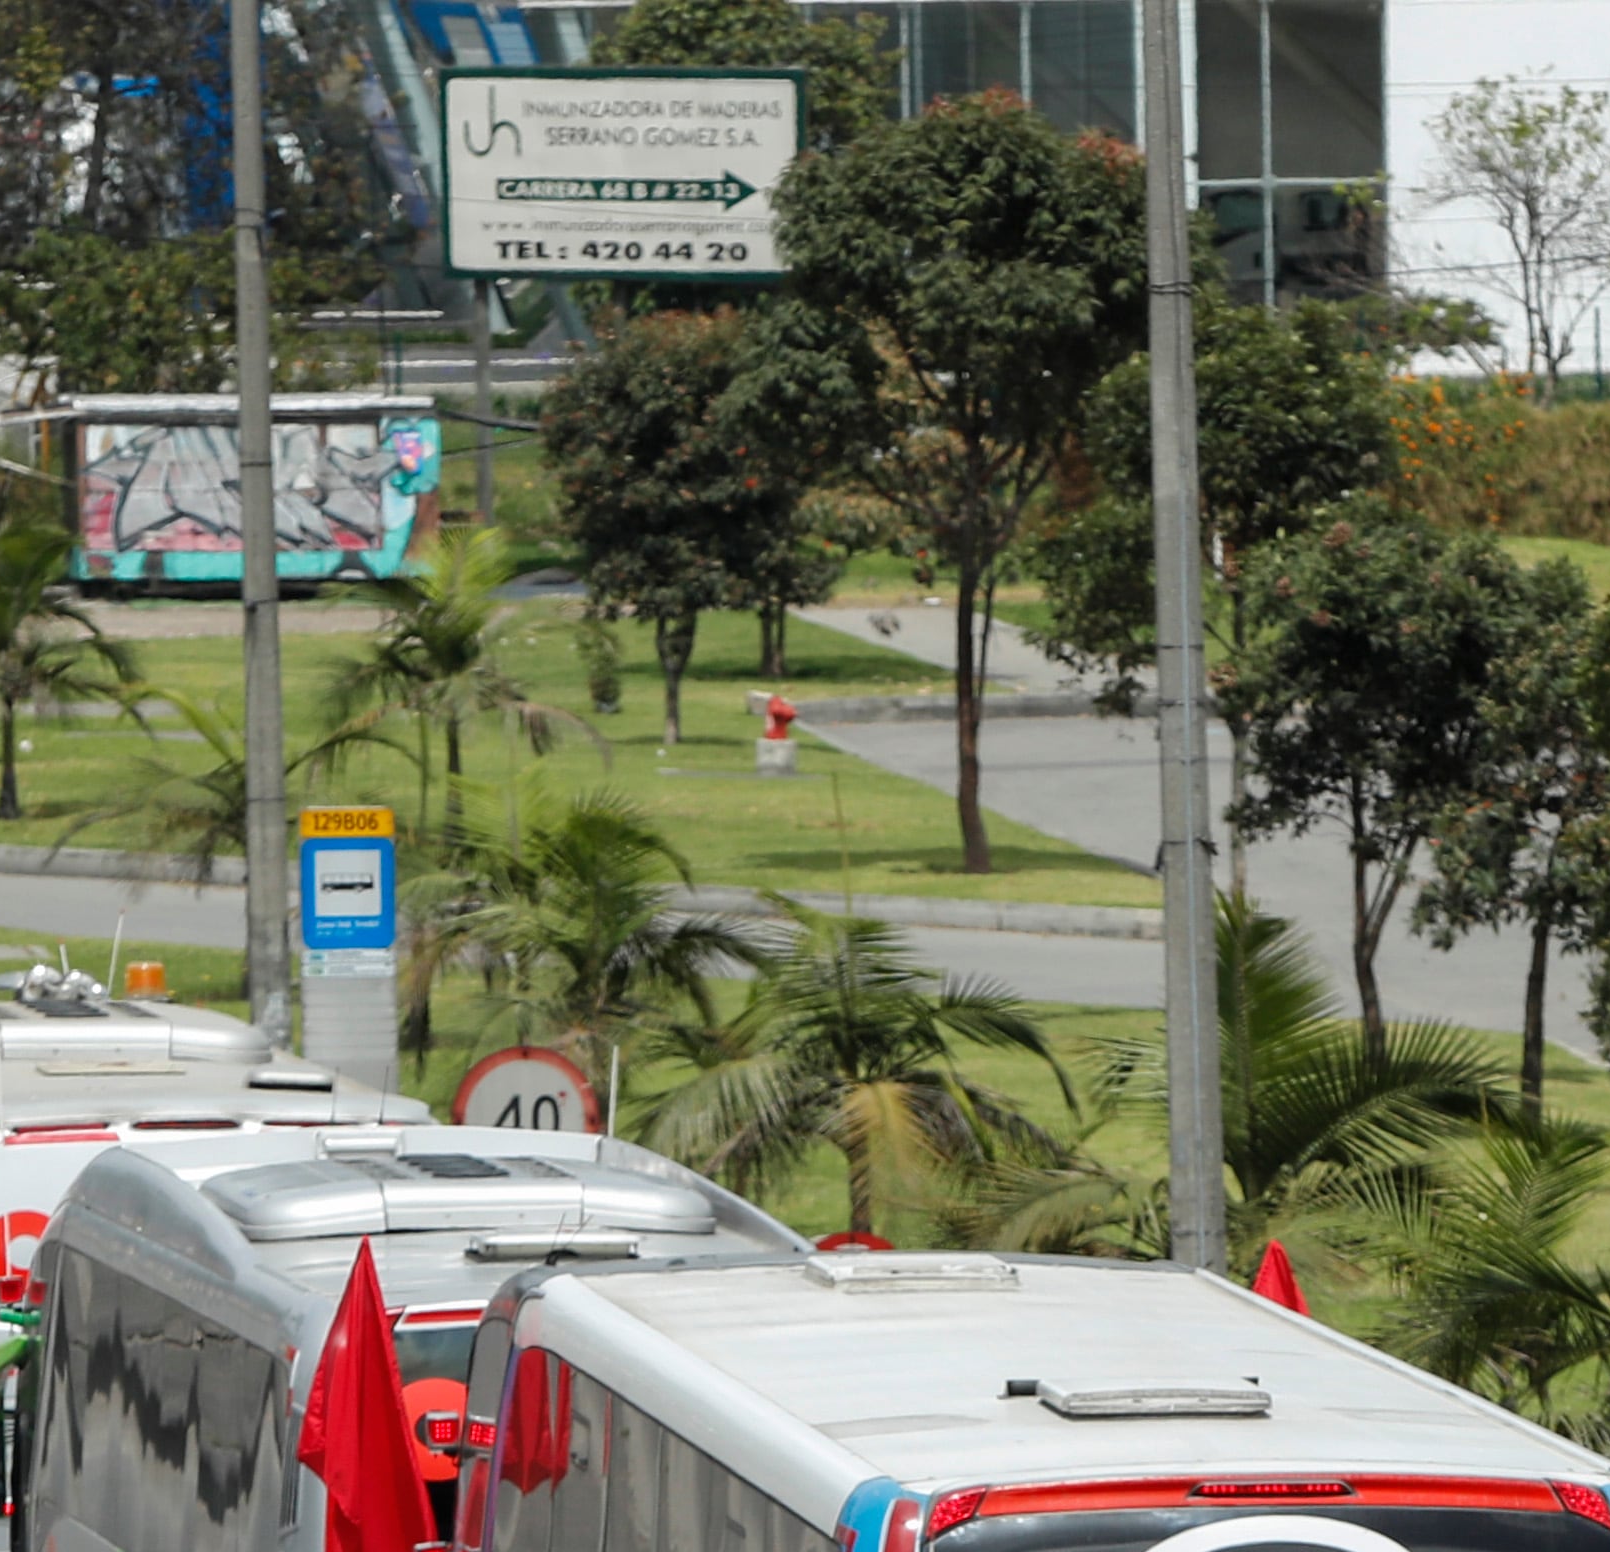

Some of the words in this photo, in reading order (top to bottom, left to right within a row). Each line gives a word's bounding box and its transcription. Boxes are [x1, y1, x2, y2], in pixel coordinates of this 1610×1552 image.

[522, 100, 665, 119] INMUNIZADORA
[669, 101, 693, 118] DE
[698, 101, 782, 119] MADERAS
[544, 127, 639, 147] SERRANO
[643, 127, 719, 147] GOMEZ
[499, 182, 597, 199] CARRERA
[581, 241, 644, 262] 420
[652, 241, 695, 261] 44
[705, 241, 749, 262] 20
[312, 812, 380, 831] 129B06
[493, 1094, 560, 1131] 40
